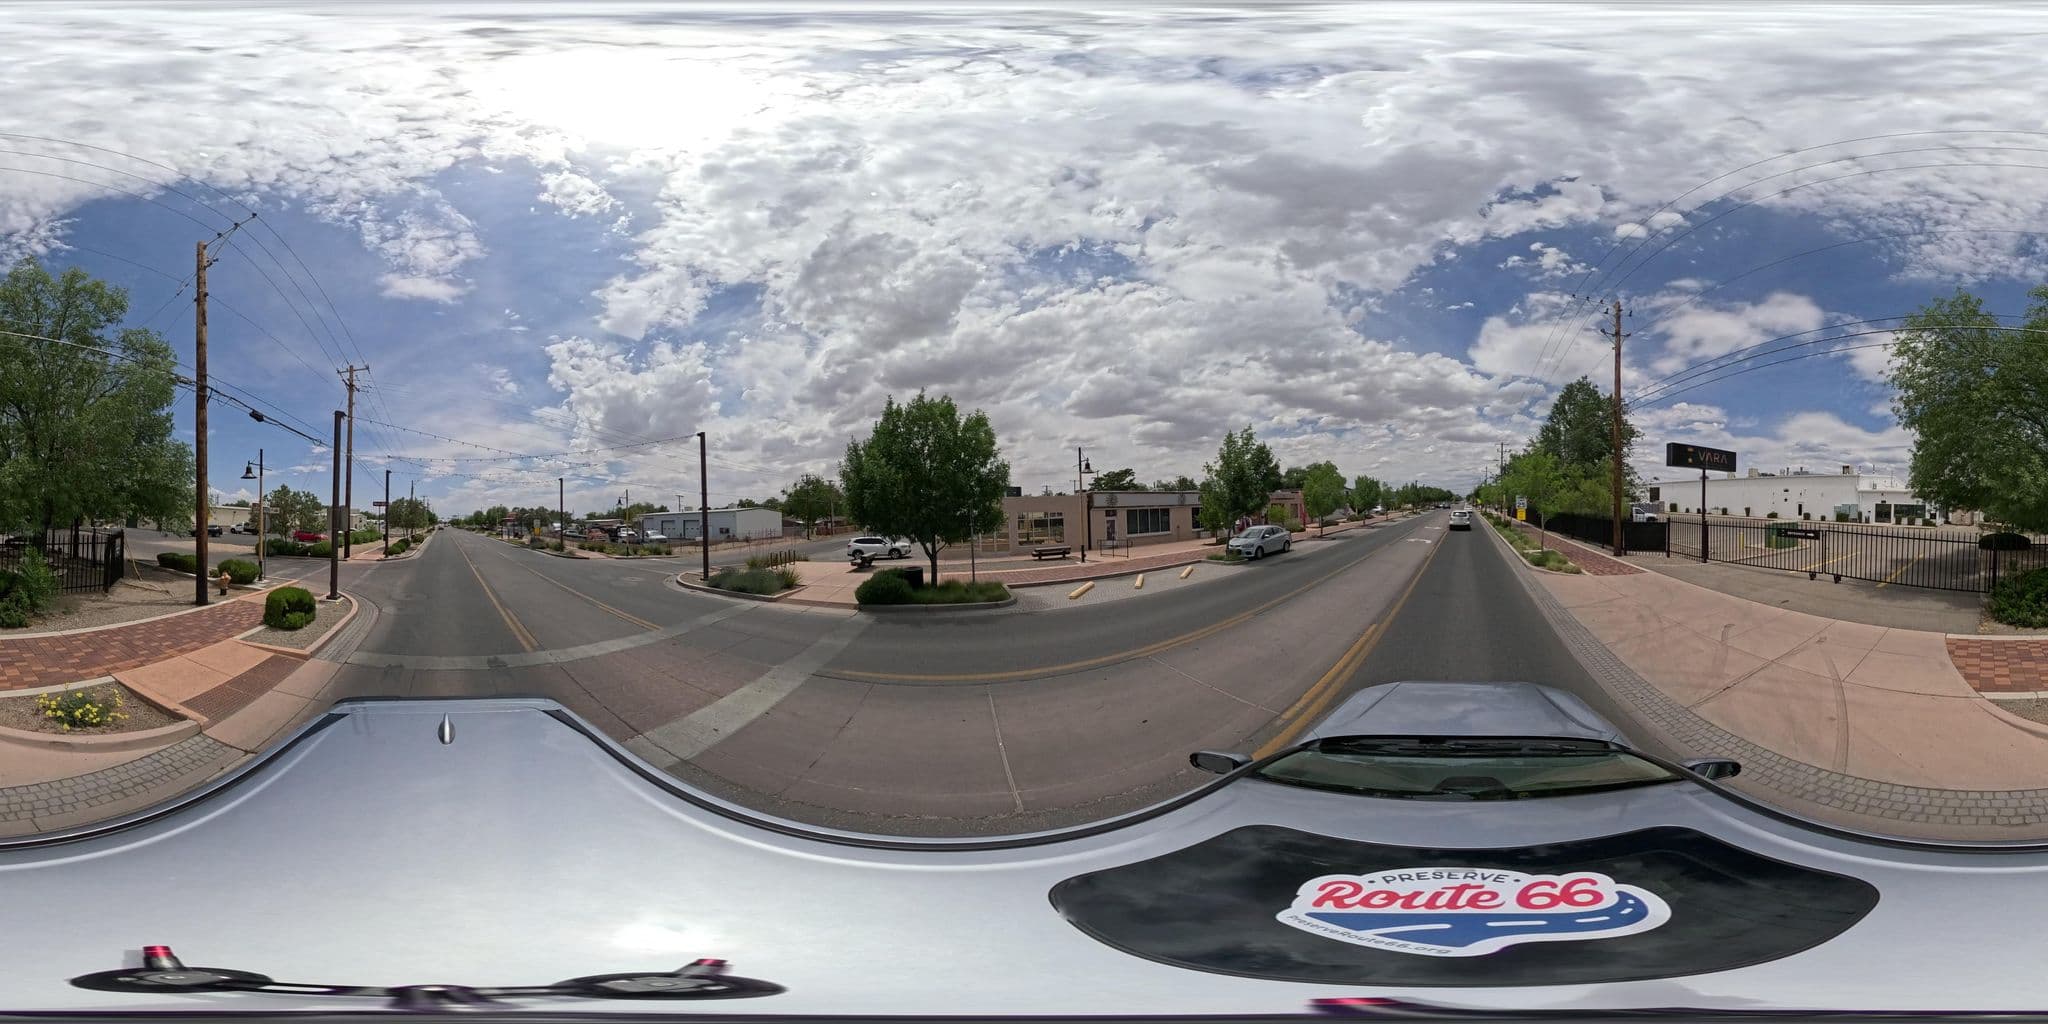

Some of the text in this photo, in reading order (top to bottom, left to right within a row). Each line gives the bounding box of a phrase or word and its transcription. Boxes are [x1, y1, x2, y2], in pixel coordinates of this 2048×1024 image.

[1698, 449, 1728, 465] VARA
[1383, 871, 1508, 884] PRESERVE
[1312, 877, 1604, 910] Route 66
[1286, 914, 1452, 954] PreserveRoute66.org
